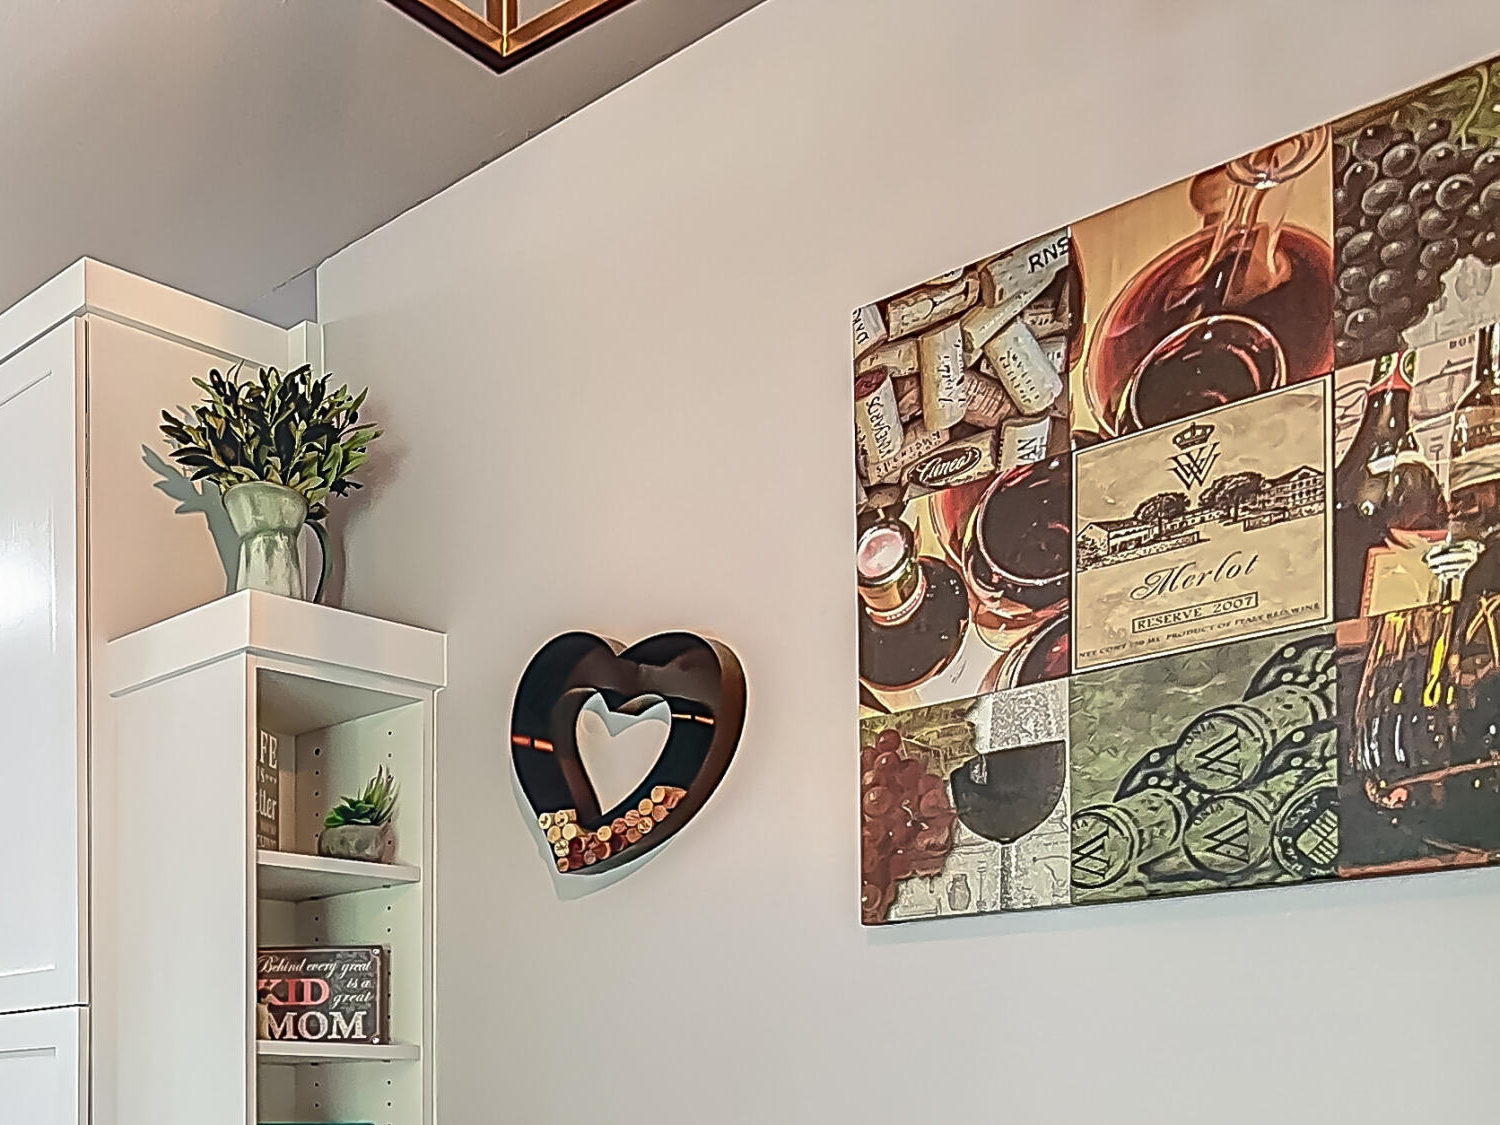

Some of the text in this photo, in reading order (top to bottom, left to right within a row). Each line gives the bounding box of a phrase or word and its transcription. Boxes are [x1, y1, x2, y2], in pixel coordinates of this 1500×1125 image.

[1130, 550, 1259, 601] Merlot
[1137, 596, 1253, 630] RESERVE 2007
[1166, 624, 1214, 640] PRODUCT
[1217, 621, 1231, 629] OF
[1235, 614, 1264, 626] ITALY
[1291, 602, 1320, 614] WINE
[259, 955, 372, 980] Behind every great
[258, 978, 331, 1006] KID
[346, 977, 371, 989] is a
[331, 991, 372, 1010] great
[267, 1010, 367, 1040] MOM
